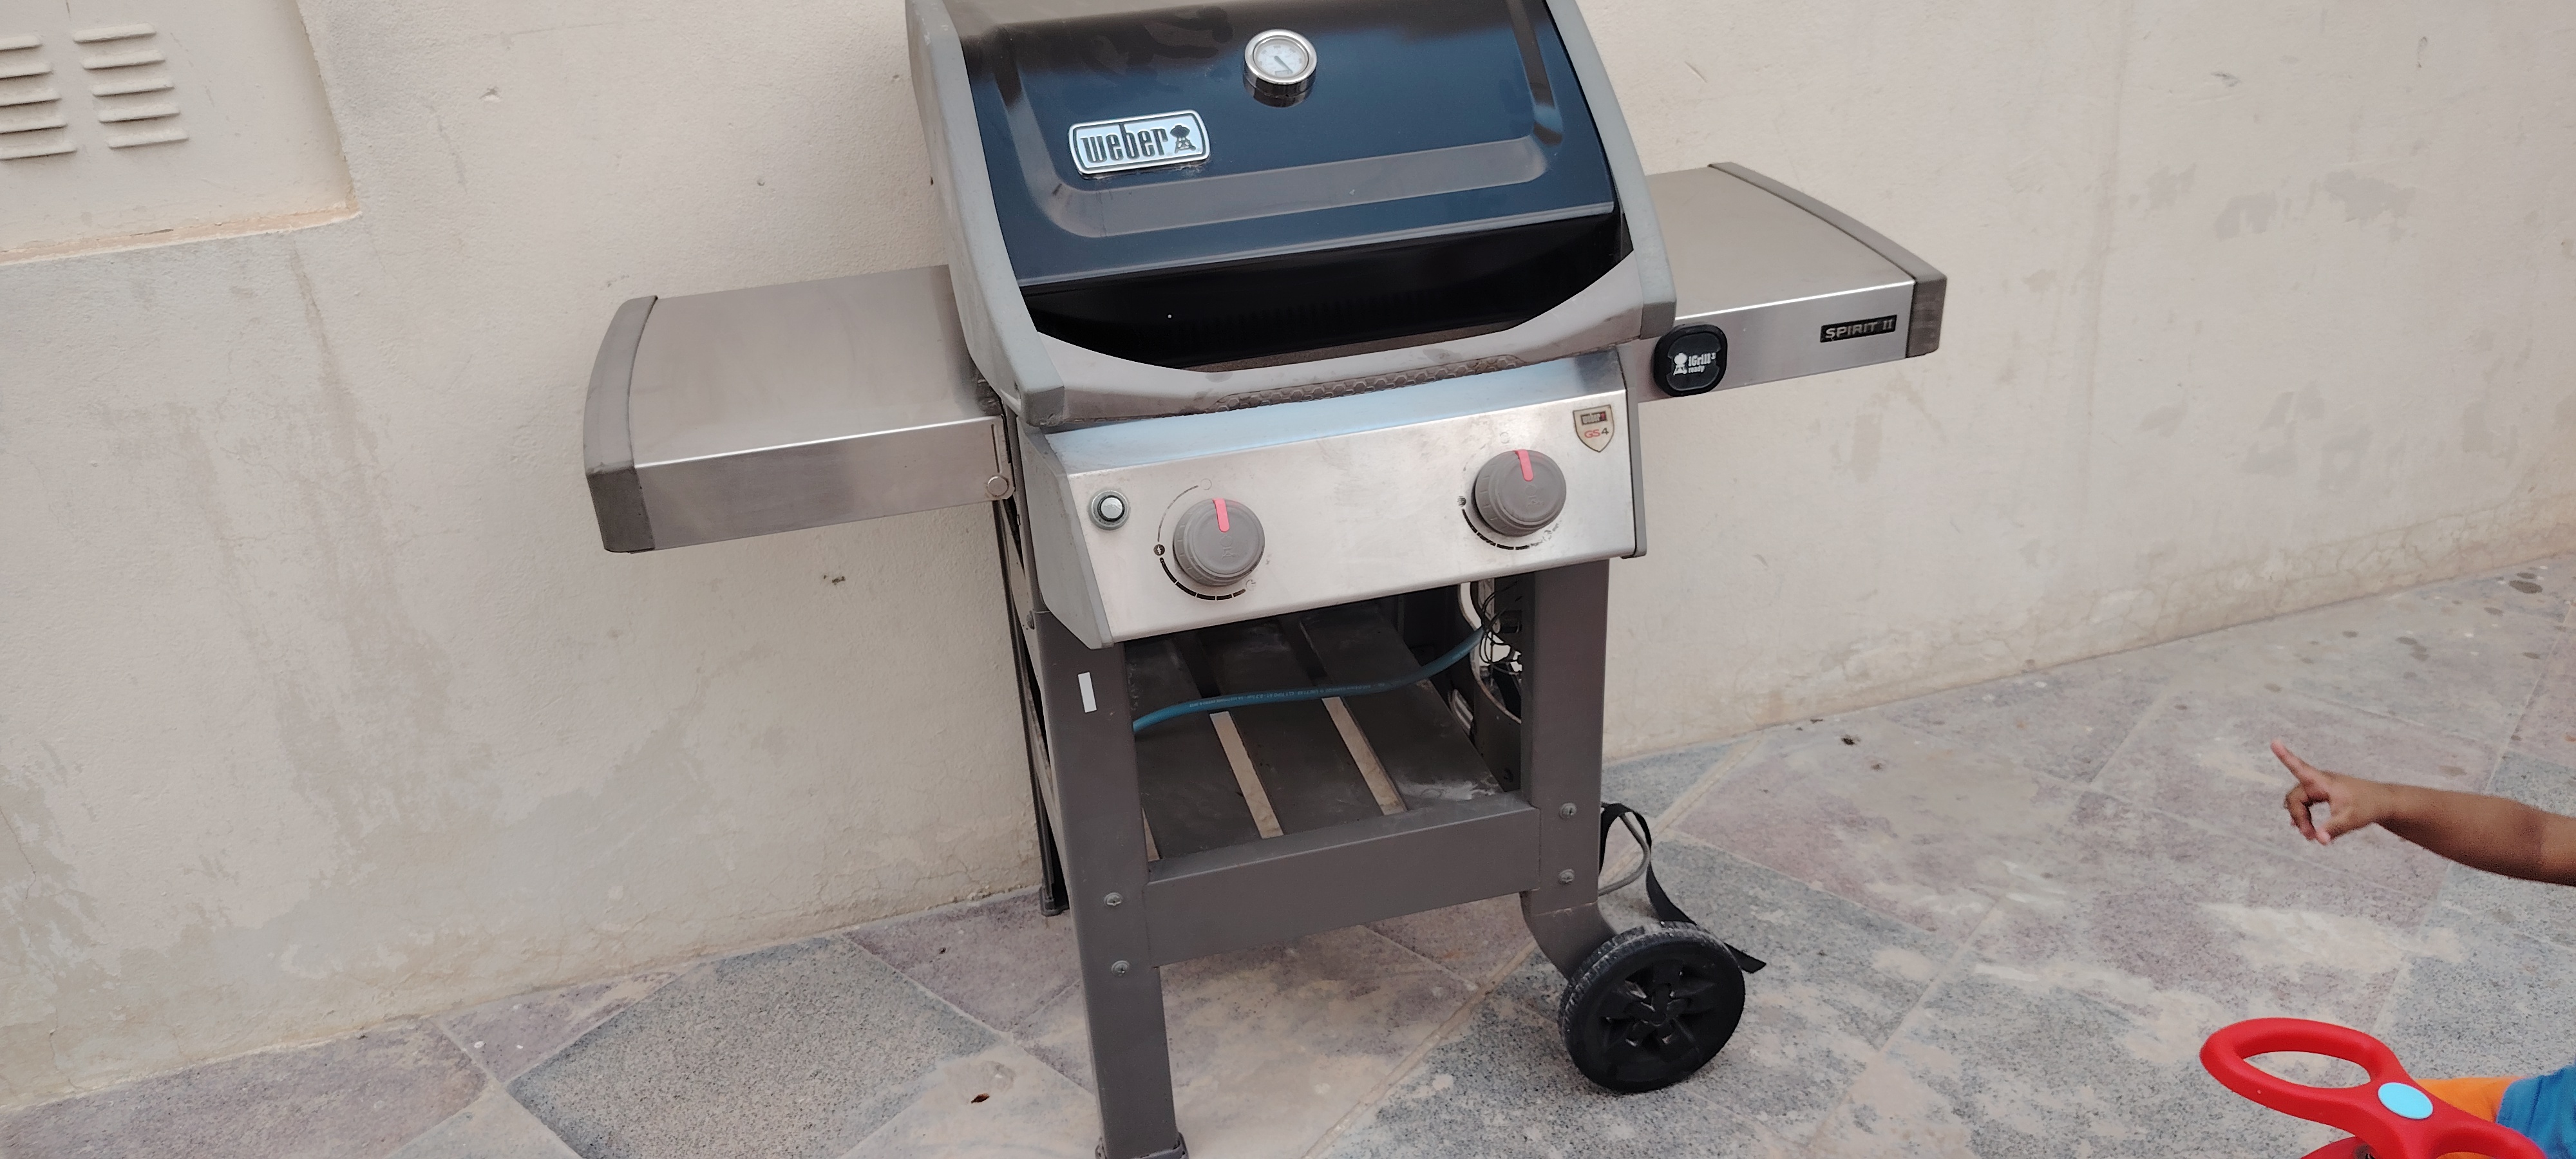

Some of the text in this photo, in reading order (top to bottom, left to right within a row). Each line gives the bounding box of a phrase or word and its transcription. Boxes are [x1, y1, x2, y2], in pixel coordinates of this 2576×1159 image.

[1080, 122, 1169, 164] weber
[1825, 319, 1893, 339] SPIRIT II
